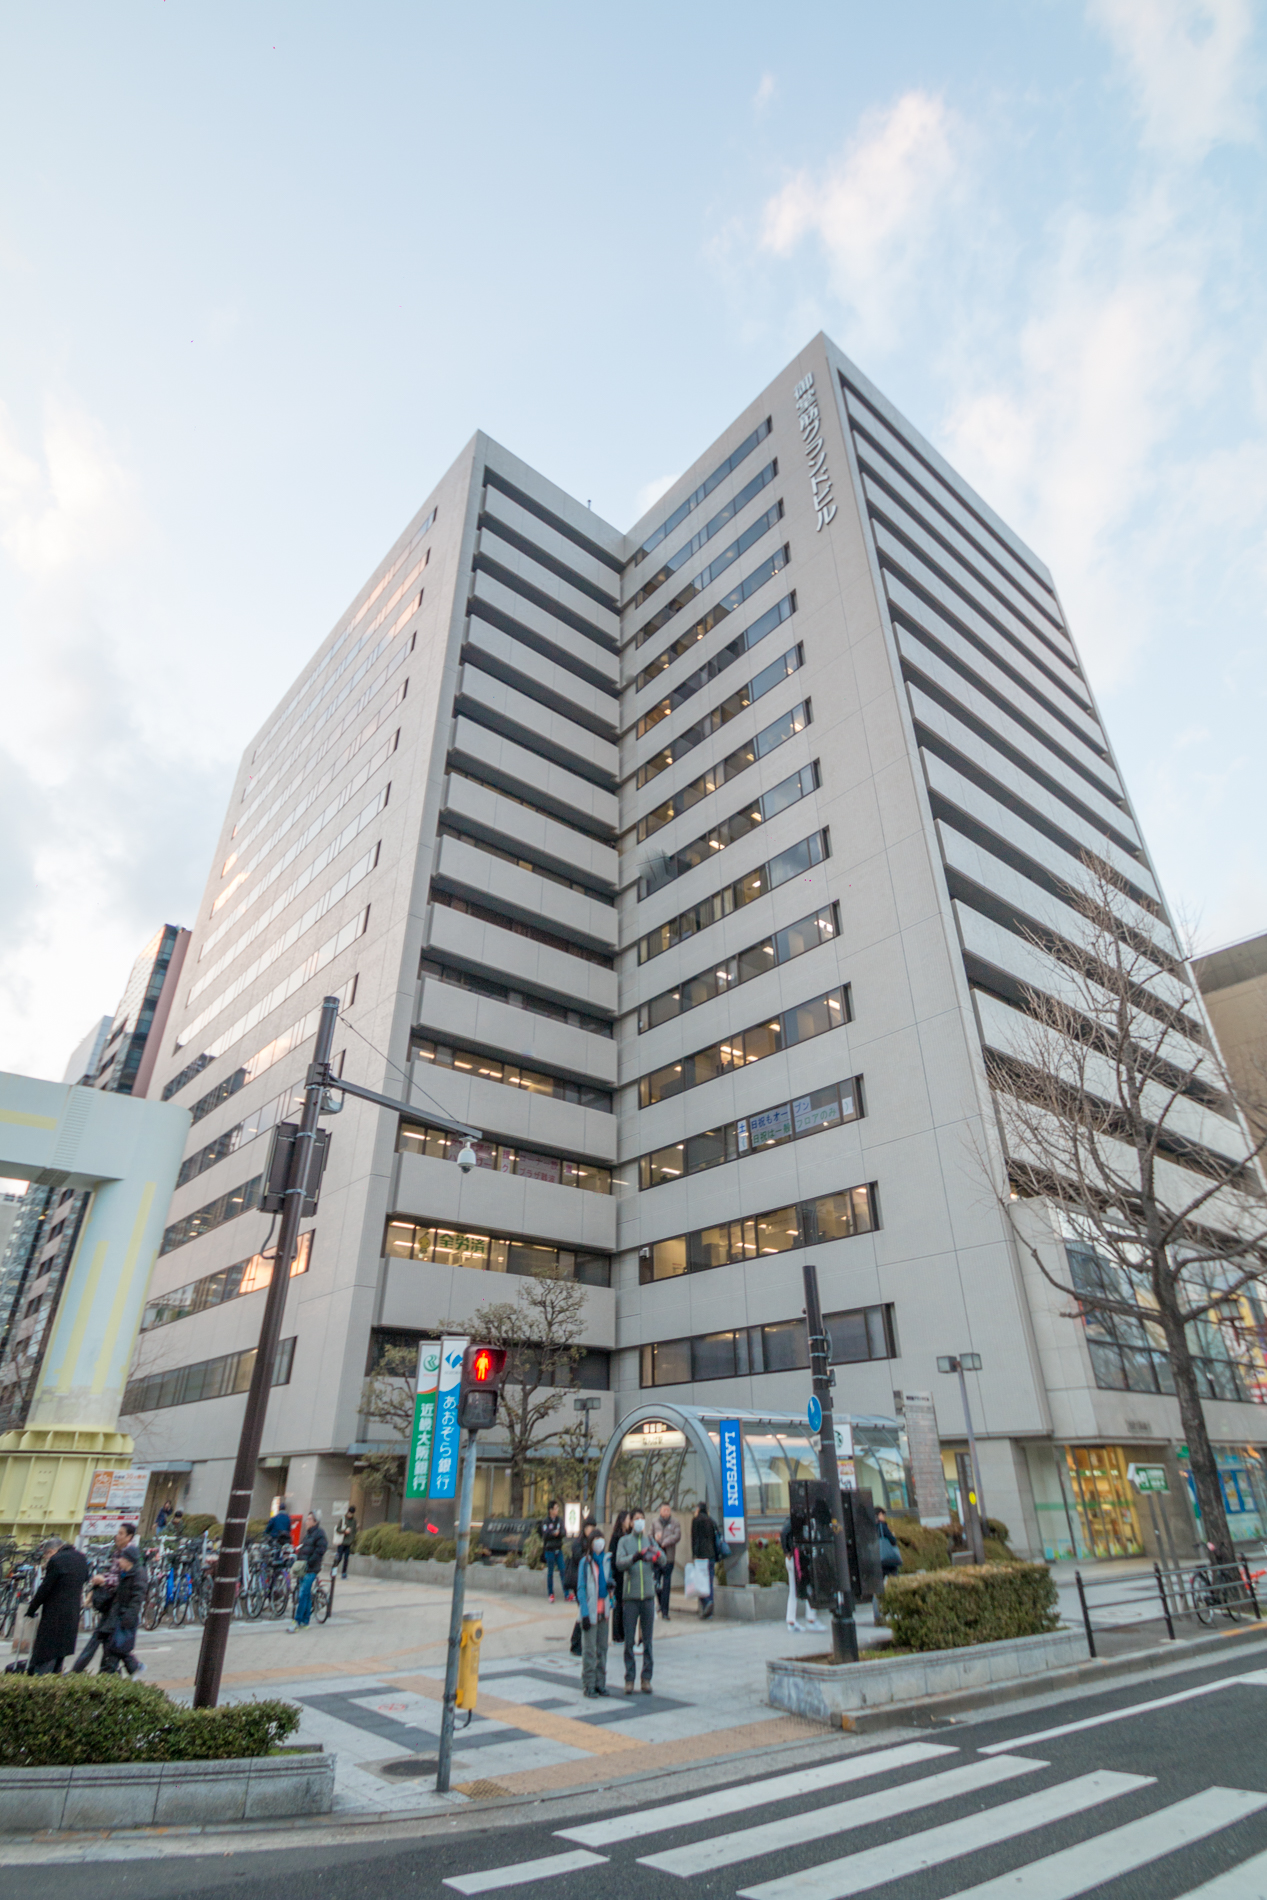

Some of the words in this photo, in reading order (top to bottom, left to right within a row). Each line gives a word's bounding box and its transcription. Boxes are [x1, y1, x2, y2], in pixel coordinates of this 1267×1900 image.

[793, 372, 837, 532] 御堂筋グランドビル
[439, 1233, 485, 1253] 全労済
[413, 1403, 434, 1491] 近畿大阪銀行
[436, 1396, 456, 1490] あおぞら銀行
[725, 1432, 738, 1506] LAWSON
